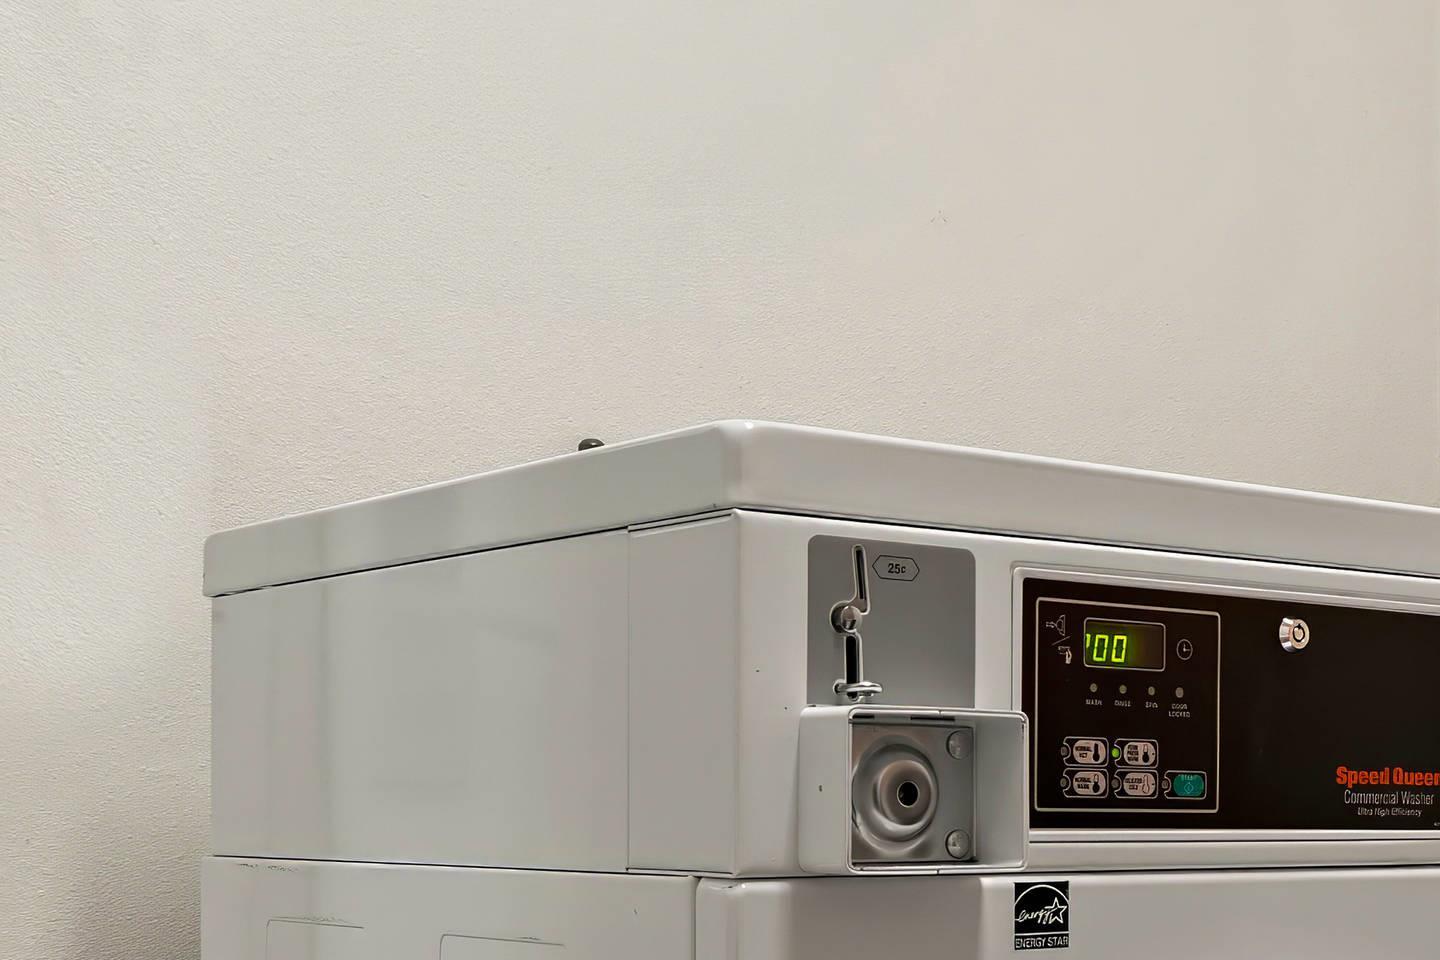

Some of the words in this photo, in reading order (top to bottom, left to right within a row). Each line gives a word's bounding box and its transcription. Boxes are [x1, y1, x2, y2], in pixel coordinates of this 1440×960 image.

[1336, 766, 1390, 788] Speed
[1344, 789, 1398, 804] Commercial
[1401, 791, 1434, 805] Washer
[1358, 807, 1373, 816] Ultra
[1391, 808, 1422, 817] Efficiency
[1015, 937, 1046, 949] ENERGY
[1047, 936, 1069, 947] STAR
